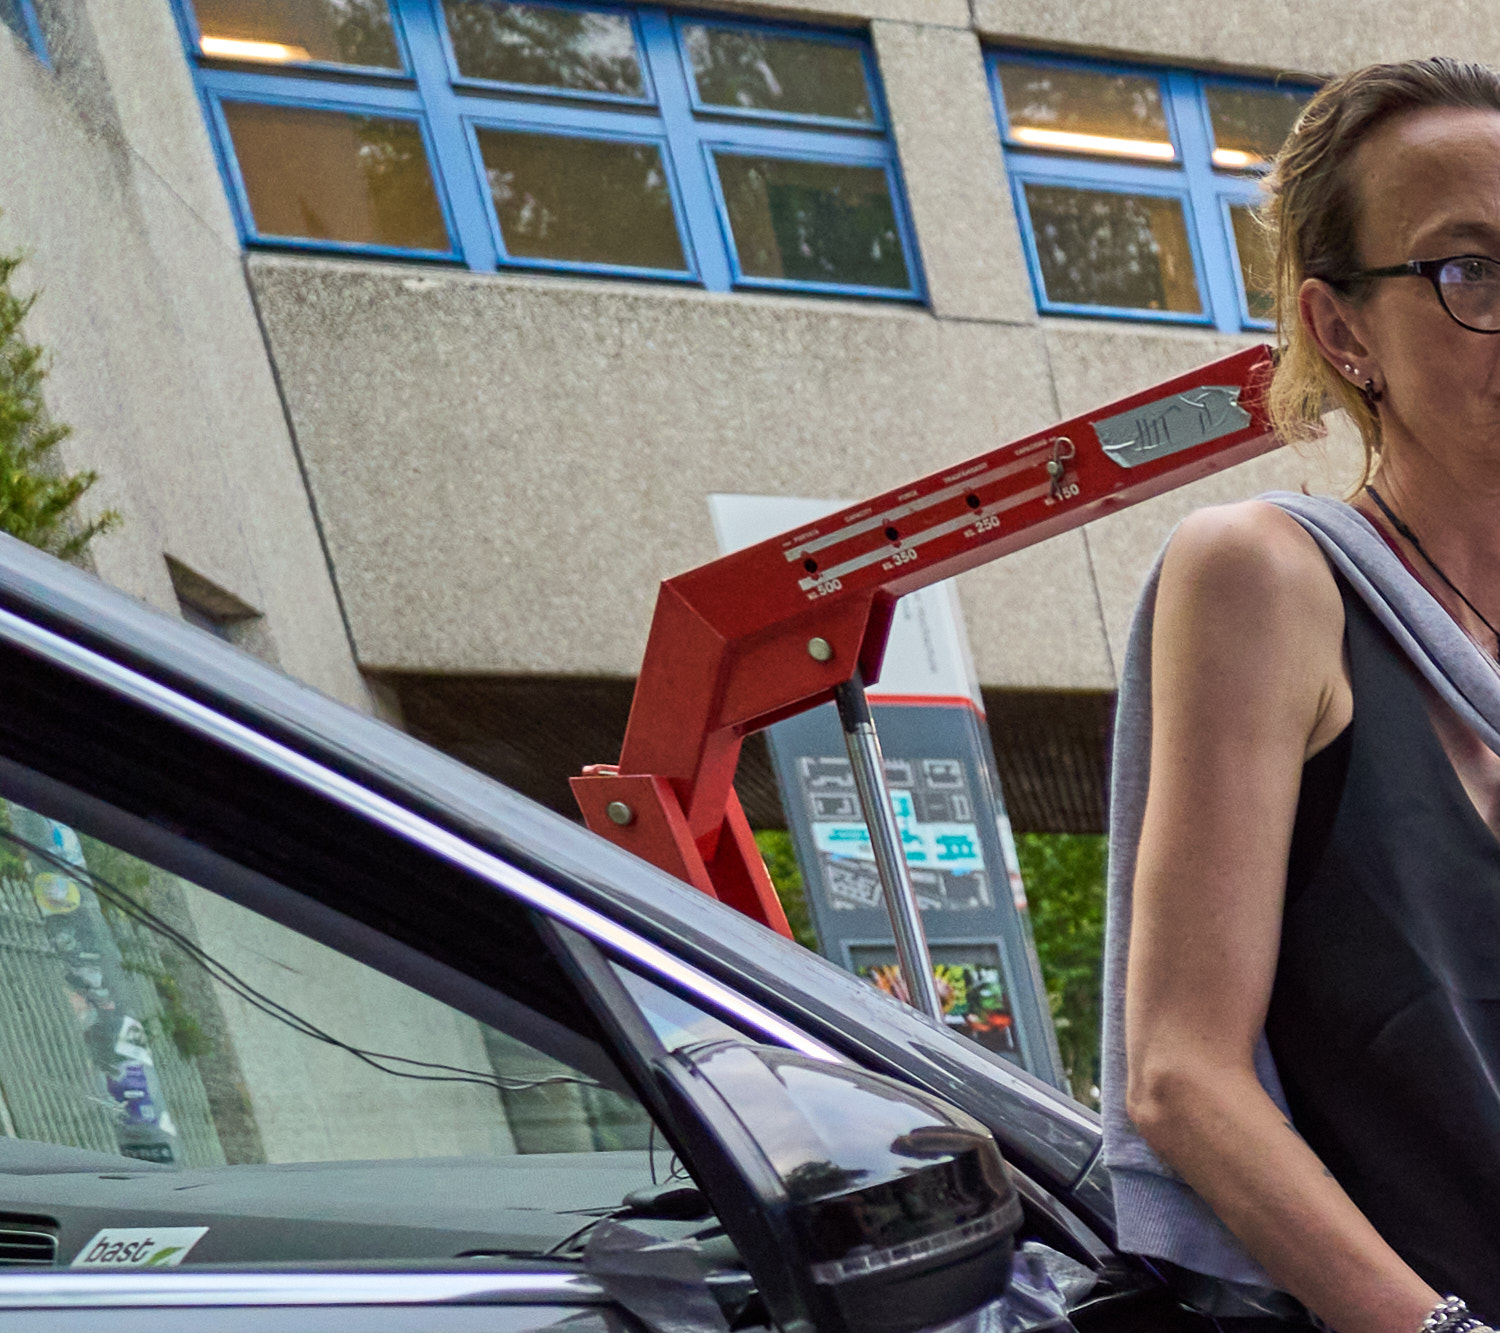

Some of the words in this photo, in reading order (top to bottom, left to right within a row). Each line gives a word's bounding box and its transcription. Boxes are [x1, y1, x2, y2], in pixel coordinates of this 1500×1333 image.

[1054, 483, 1080, 502] 150
[974, 515, 1001, 534] 250
[892, 548, 918, 567] 350
[816, 578, 843, 597] 500
[84, 1236, 155, 1263] bast
